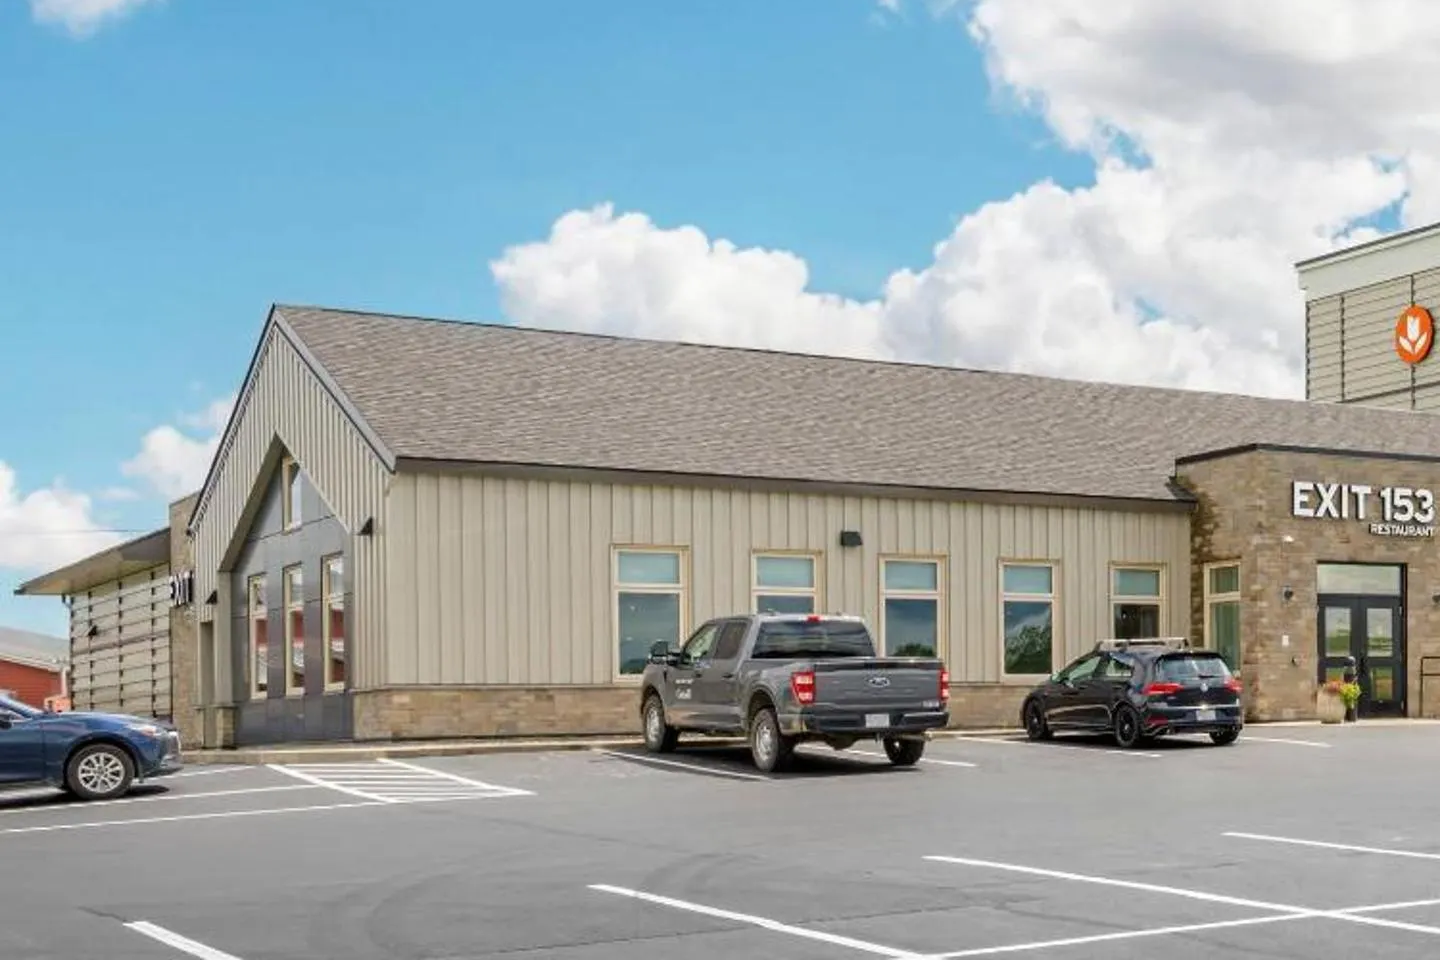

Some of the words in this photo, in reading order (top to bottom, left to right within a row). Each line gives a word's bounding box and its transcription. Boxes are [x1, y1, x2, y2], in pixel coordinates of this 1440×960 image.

[1293, 480, 1371, 520] EXIT
[1379, 486, 1435, 523] 153
[1369, 523, 1434, 537] RESTAURANT
